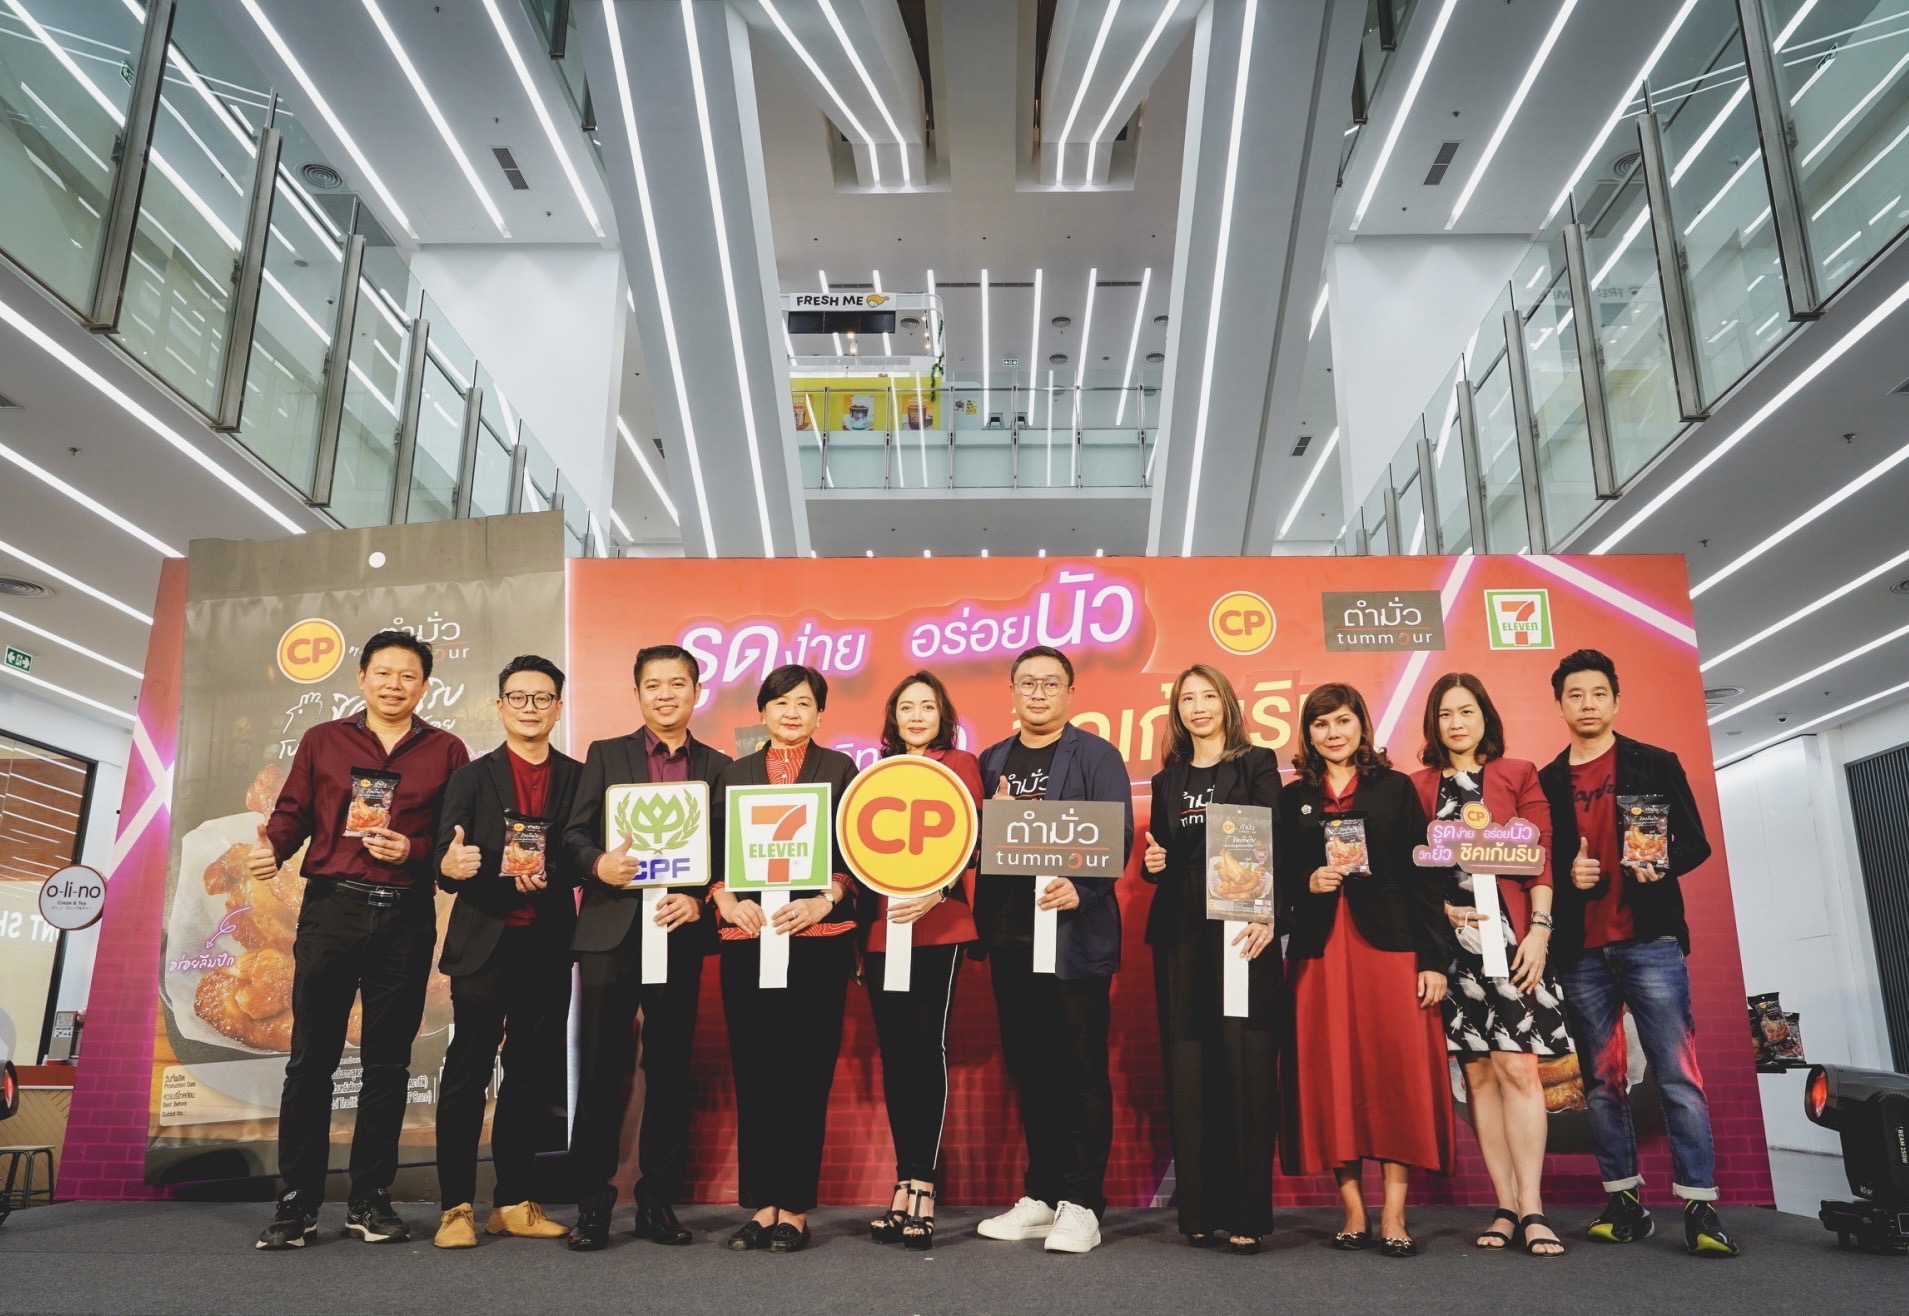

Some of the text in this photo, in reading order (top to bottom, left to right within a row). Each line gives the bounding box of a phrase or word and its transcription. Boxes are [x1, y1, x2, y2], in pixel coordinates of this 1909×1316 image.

[796, 295, 863, 306] FRESH ME
[1219, 610, 1265, 636] CP
[1344, 597, 1422, 626] ตำมั่ว
[287, 637, 335, 665] CP
[857, 797, 956, 855] CP
[1006, 808, 1099, 844] ตำมั่ว
[1467, 811, 1485, 822] CP
[1460, 841, 1540, 862] ชิคเก้นริบ
[46, 881, 101, 899] o-li-no
